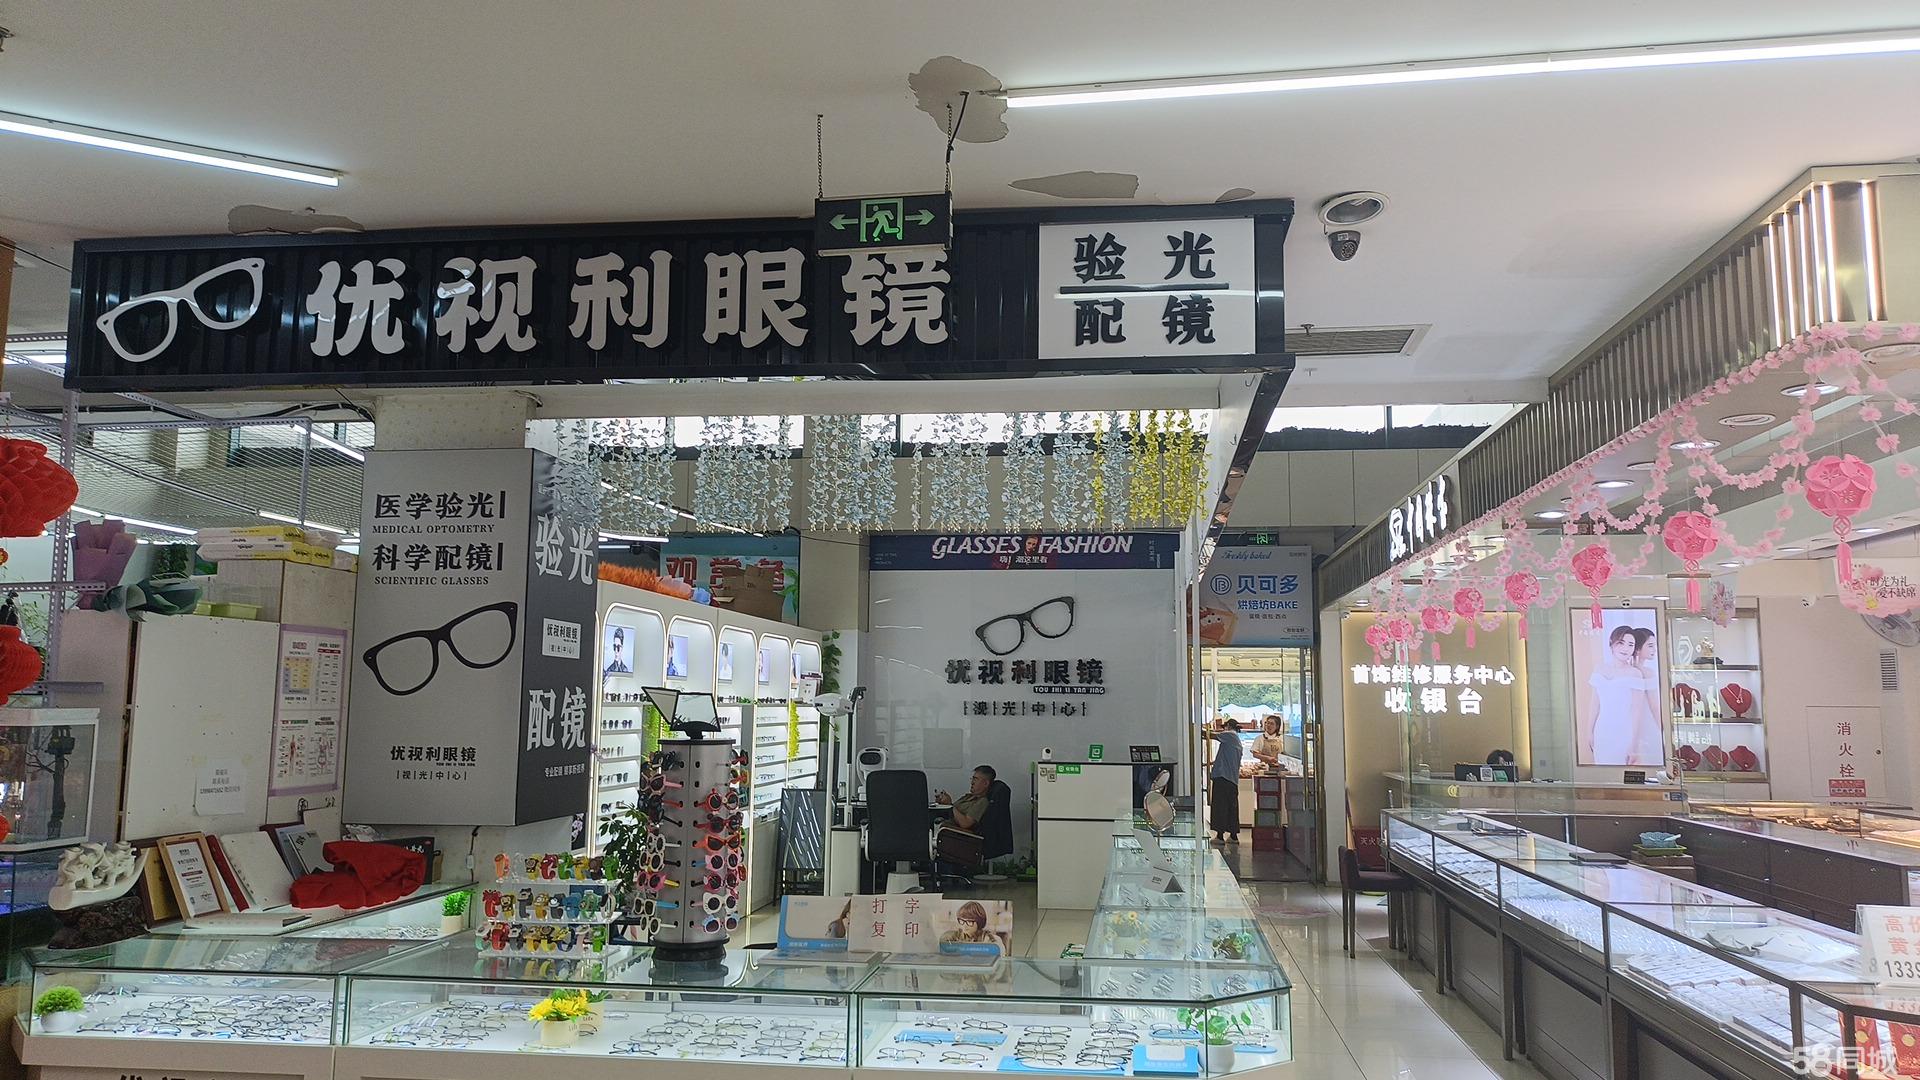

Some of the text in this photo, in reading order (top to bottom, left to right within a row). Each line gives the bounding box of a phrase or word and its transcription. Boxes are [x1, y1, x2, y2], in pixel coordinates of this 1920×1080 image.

[1074, 230, 1216, 283] 验光
[305, 247, 951, 358] 优视利眼镜
[1074, 293, 1216, 347] 配镜
[375, 491, 494, 520] 医学验光
[372, 524, 495, 534] MEDICAL OPTOMETRY
[372, 543, 493, 571] 科学配镜
[535, 513, 594, 585] 验光
[932, 536, 1021, 559] GLASSES
[1038, 536, 1133, 553] FASHION
[1250, 551, 1273, 560] baked
[374, 576, 489, 585] SCIENTIFIC GLASSES
[1236, 575, 1298, 595] 贝可多
[1870, 576, 1908, 587] 时光为礼
[1879, 587, 1916, 598] 爱不缺席
[945, 658, 1103, 685] 优视利眼镜
[1351, 664, 1515, 685] 首饰维修服务中心
[1384, 687, 1483, 715] 收银台
[526, 686, 587, 751] 配镜
[390, 745, 477, 762] 优视利眼镜
[1837, 721, 1855, 778] 消火栓
